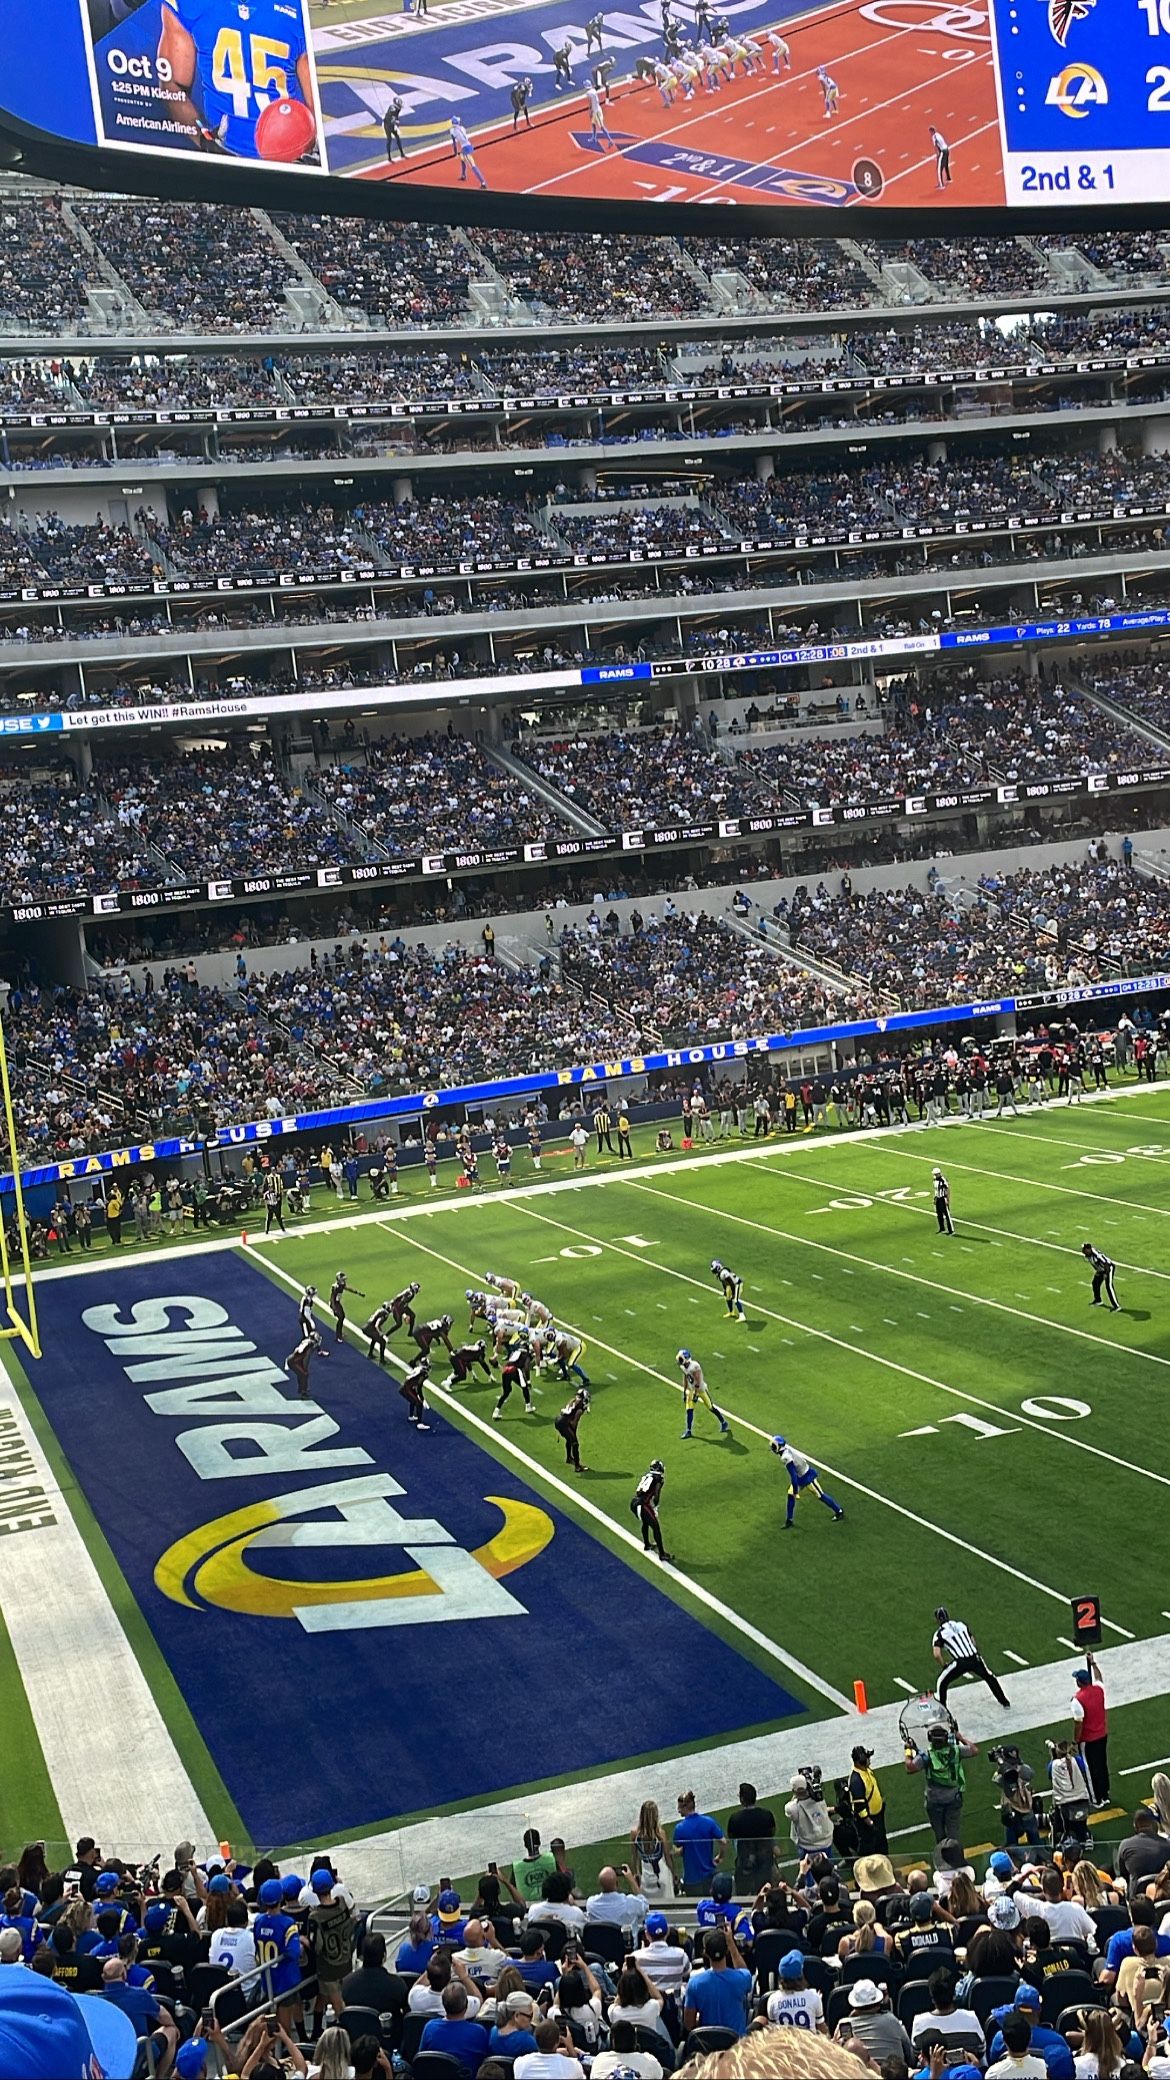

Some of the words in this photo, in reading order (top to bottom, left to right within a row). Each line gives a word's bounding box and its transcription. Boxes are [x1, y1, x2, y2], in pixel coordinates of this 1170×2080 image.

[323, 21, 403, 41] END
[107, 49, 152, 79] Oct
[155, 57, 172, 82] 9
[213, 27, 290, 118] 45
[111, 80, 132, 95] 1:25
[133, 84, 150, 97] PM
[151, 86, 186, 102] Kickoff
[116, 113, 161, 131] American
[161, 118, 198, 136] Airlines
[863, 172, 872, 187] 8
[1021, 166, 1071, 191] 2nd
[1077, 164, 1097, 190] &
[1102, 164, 1115, 190] 1
[1057, 623, 1070, 633] 22
[1098, 618, 1111, 628] 78
[957, 632, 990, 644] RAMS
[795, 649, 824, 661] 12:28
[851, 646, 868, 655] 2nd
[701, 659, 714, 670] 10
[716, 657, 731, 668] 28
[599, 668, 634, 680] RAMS
[69, 715, 88, 728] Let
[91, 713, 110, 728] get
[114, 708, 135, 722] this
[138, 708, 169, 720] WIN!!
[172, 702, 248, 718] #RamsHouse
[1117, 773, 1138, 785] 1800
[1026, 785, 1048, 797] 1800
[936, 795, 957, 807] 1800
[843, 807, 865, 819] 1800
[750, 818, 771, 830] 1800
[654, 830, 676, 842] 1800
[556, 842, 579, 854] 1800
[455, 854, 479, 867] 1800
[352, 866, 376, 879] 1800
[244, 879, 269, 892] 1800
[131, 892, 157, 906] 1800
[13, 906, 41, 921] 1800
[1132, 979, 1157, 990] 12:28
[1055, 993, 1067, 1003] 10
[1068, 991, 1080, 1001] 28
[972, 1004, 1001, 1015] RAMS
[558, 1059, 646, 1085] RAMS
[667, 1039, 770, 1067] HOUSE
[58, 1144, 155, 1179] RAMS
[81, 1295, 377, 1480] RAMS
[938, 1395, 1093, 1440] 10
[1077, 1601, 1097, 1629] 2
[911, 1932, 939, 1946] DONALD
[1043, 1959, 1070, 1977] DONALD
[777, 1997, 807, 2010] DONALD
